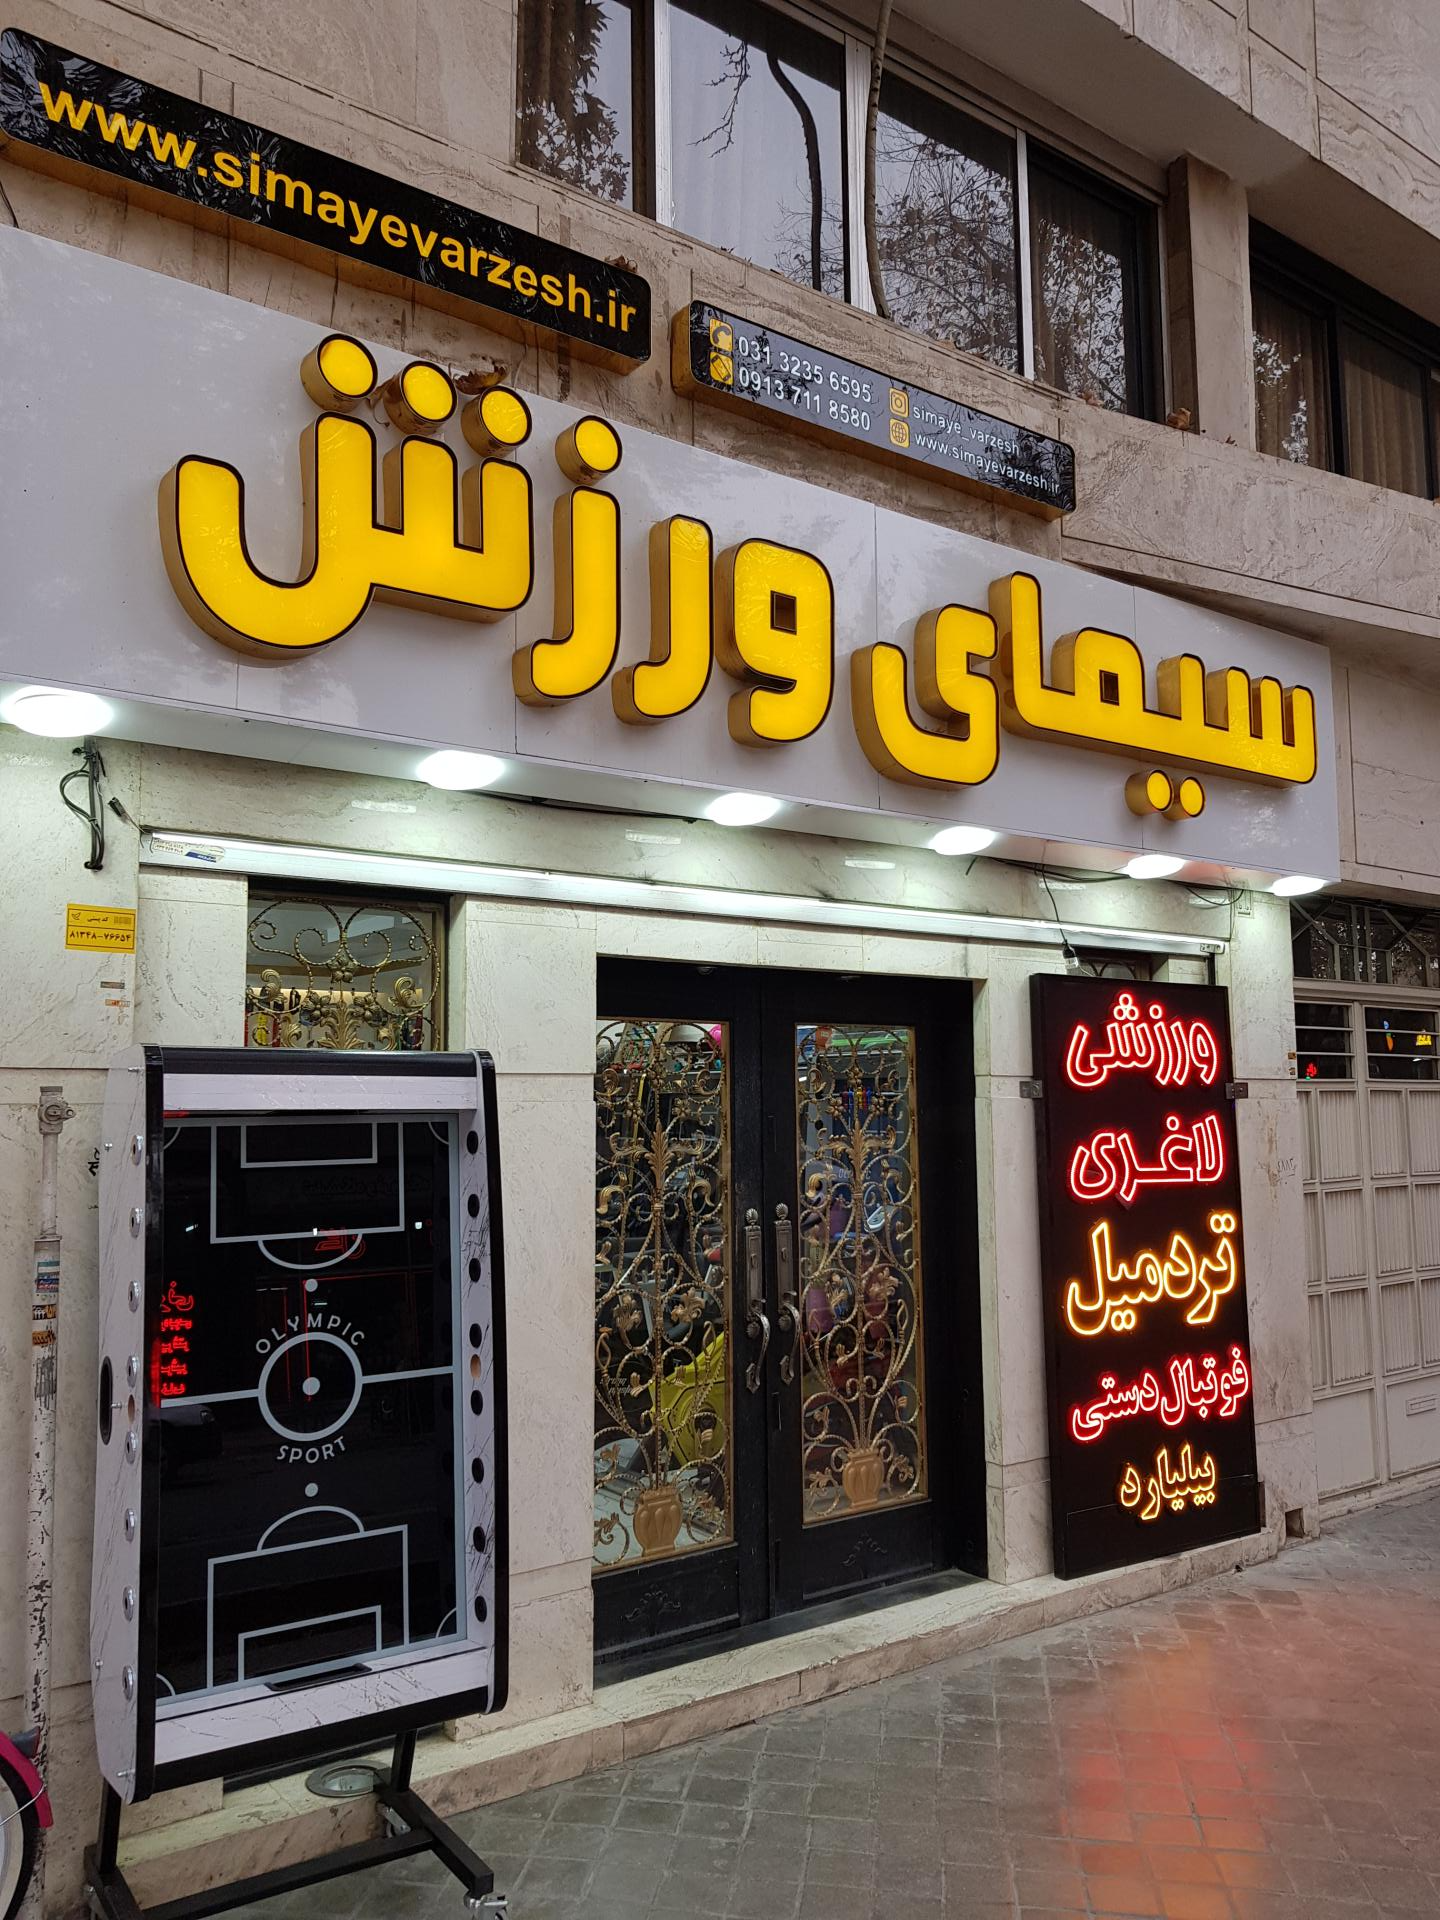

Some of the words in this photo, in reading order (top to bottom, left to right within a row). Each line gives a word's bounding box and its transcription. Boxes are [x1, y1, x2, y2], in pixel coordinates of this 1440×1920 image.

[38, 80, 638, 333] www.simayevarzesh.ir
[737, 334, 773, 366] 031
[779, 350, 825, 385] 3235
[829, 369, 873, 403] 6595
[738, 366, 786, 400] 0913
[791, 385, 823, 415] 711
[828, 399, 873, 432] 8580
[912, 403, 1021, 458] simaye_varzesh
[914, 433, 1062, 495] www.simayevarzesh.ir
[172, 334, 834, 744] ورزش
[866, 572, 1318, 818] سیمای
[1065, 991, 1220, 1088] ورزشی
[1068, 1112, 1227, 1203] لاغری
[1065, 1210, 1239, 1337] تردمیل
[255, 1313, 367, 1355] OLYMPIC
[1070, 1371, 1161, 1443] دستی
[1159, 1344, 1252, 1428] فوتبال
[276, 1436, 350, 1464] SPORT
[1119, 1442, 1217, 1522] بیلیارد
